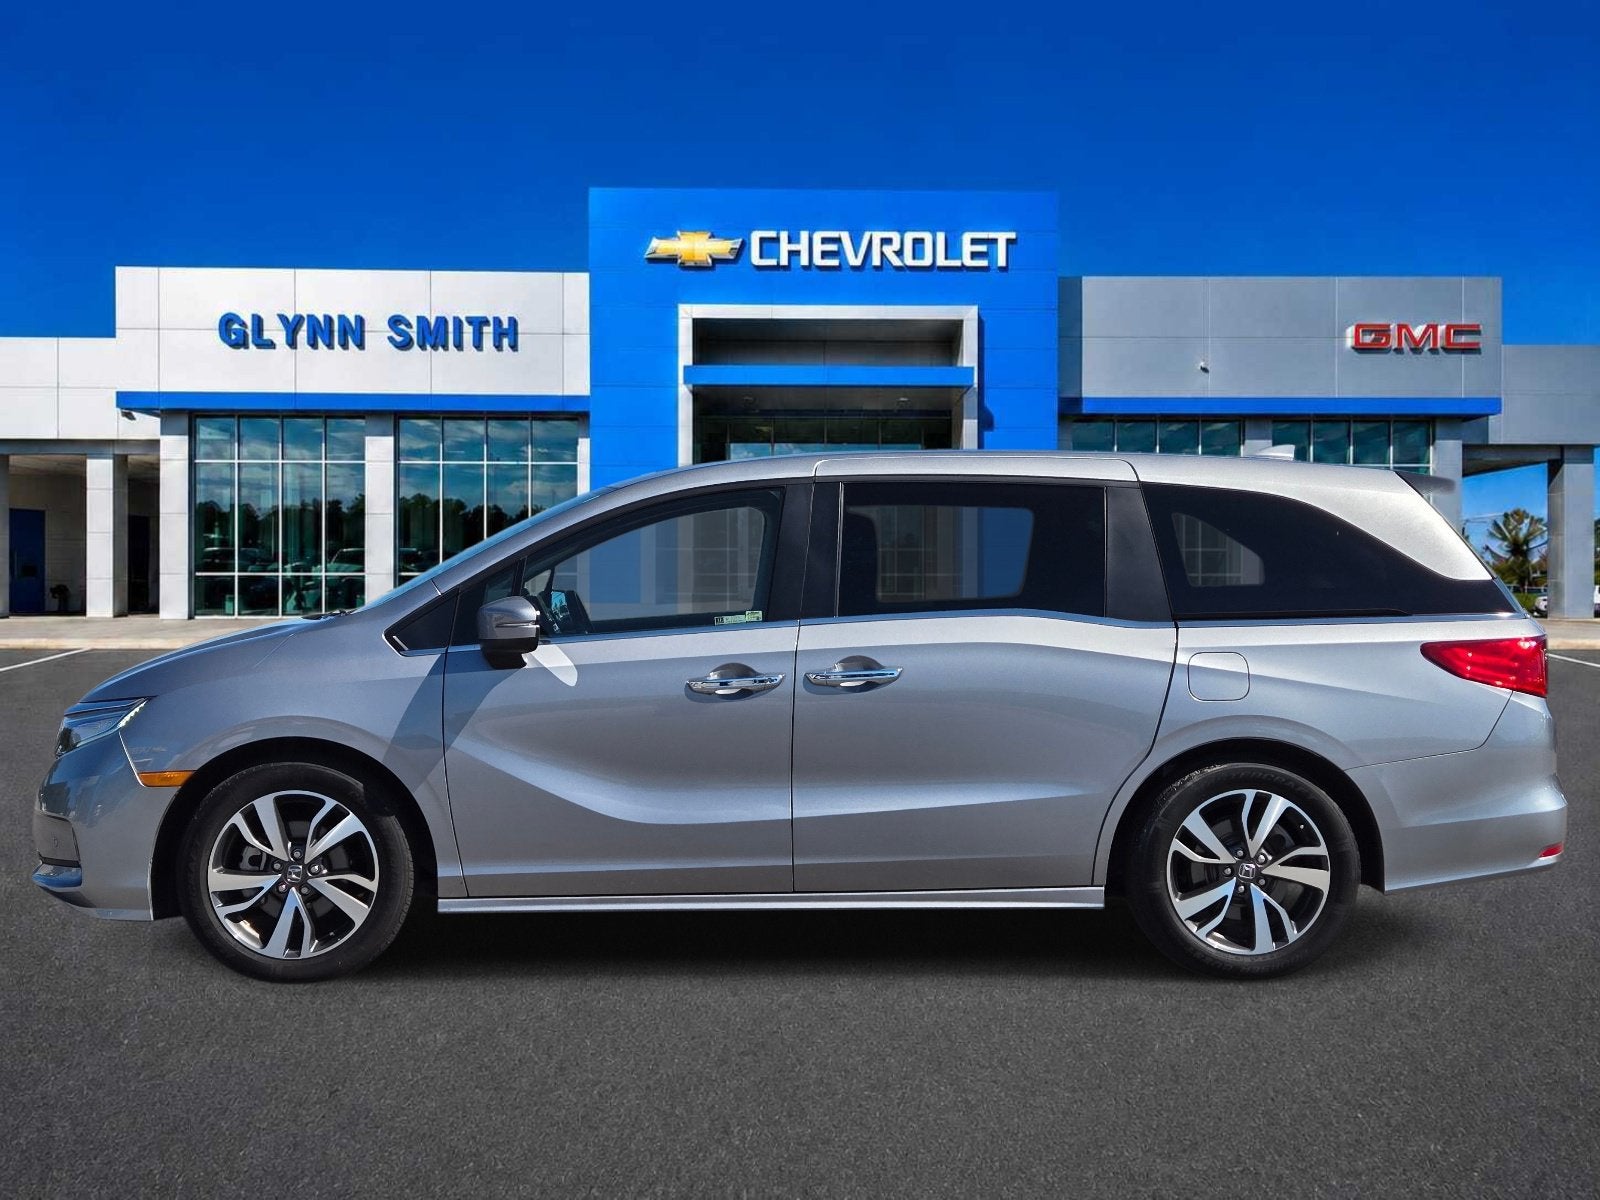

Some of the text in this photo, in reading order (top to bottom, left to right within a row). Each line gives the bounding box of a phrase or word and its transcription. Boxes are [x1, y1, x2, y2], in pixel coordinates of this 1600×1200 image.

[750, 230, 1017, 269] CHEVROLET
[217, 311, 519, 352] GLYNN SMITH
[1352, 322, 1482, 352] GMC
